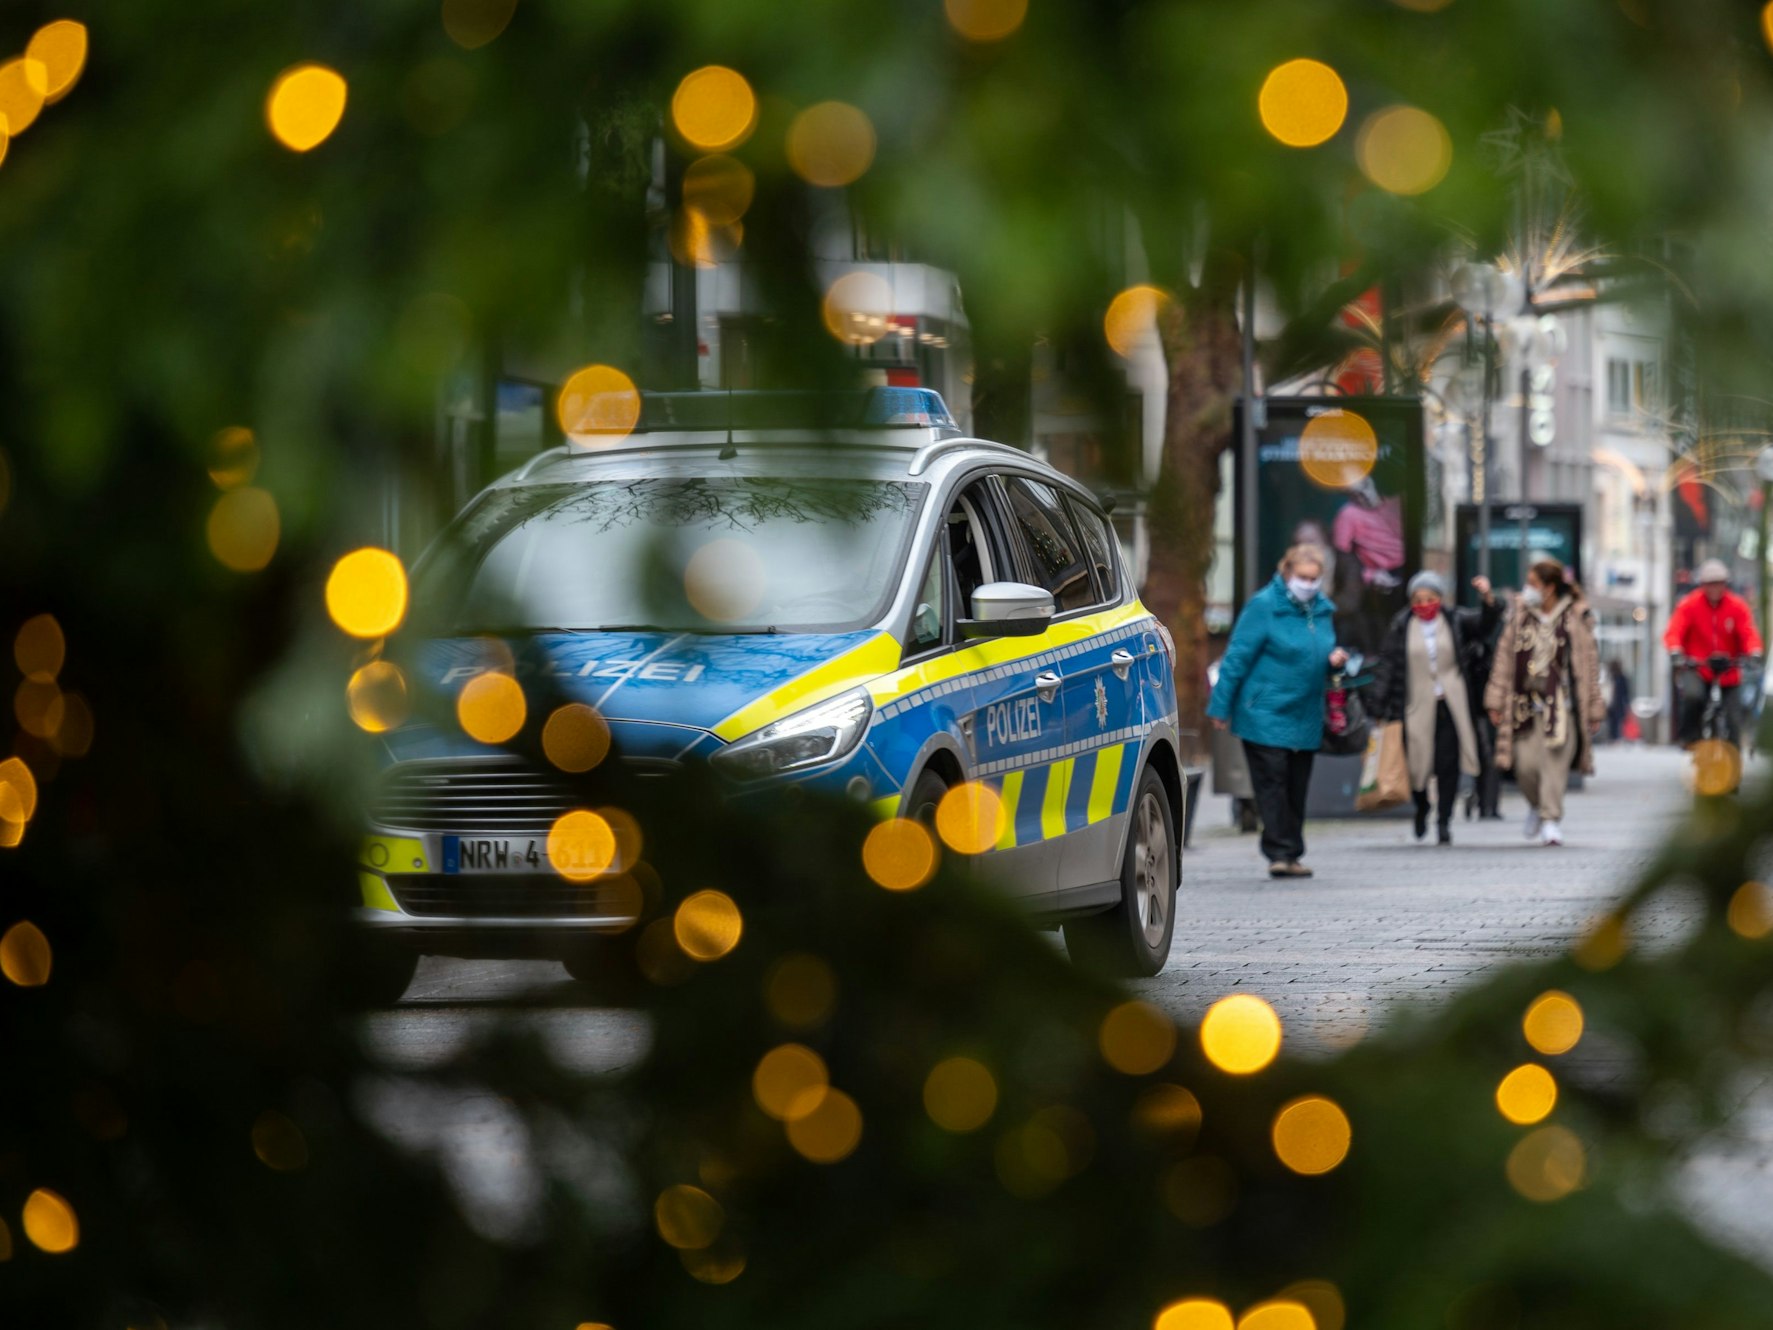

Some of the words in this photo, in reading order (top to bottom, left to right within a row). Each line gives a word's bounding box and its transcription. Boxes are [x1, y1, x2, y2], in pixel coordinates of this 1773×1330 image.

[440, 660, 705, 684] PLIZEI
[987, 697, 1042, 747] POLIZEI
[460, 840, 509, 868] NRW
